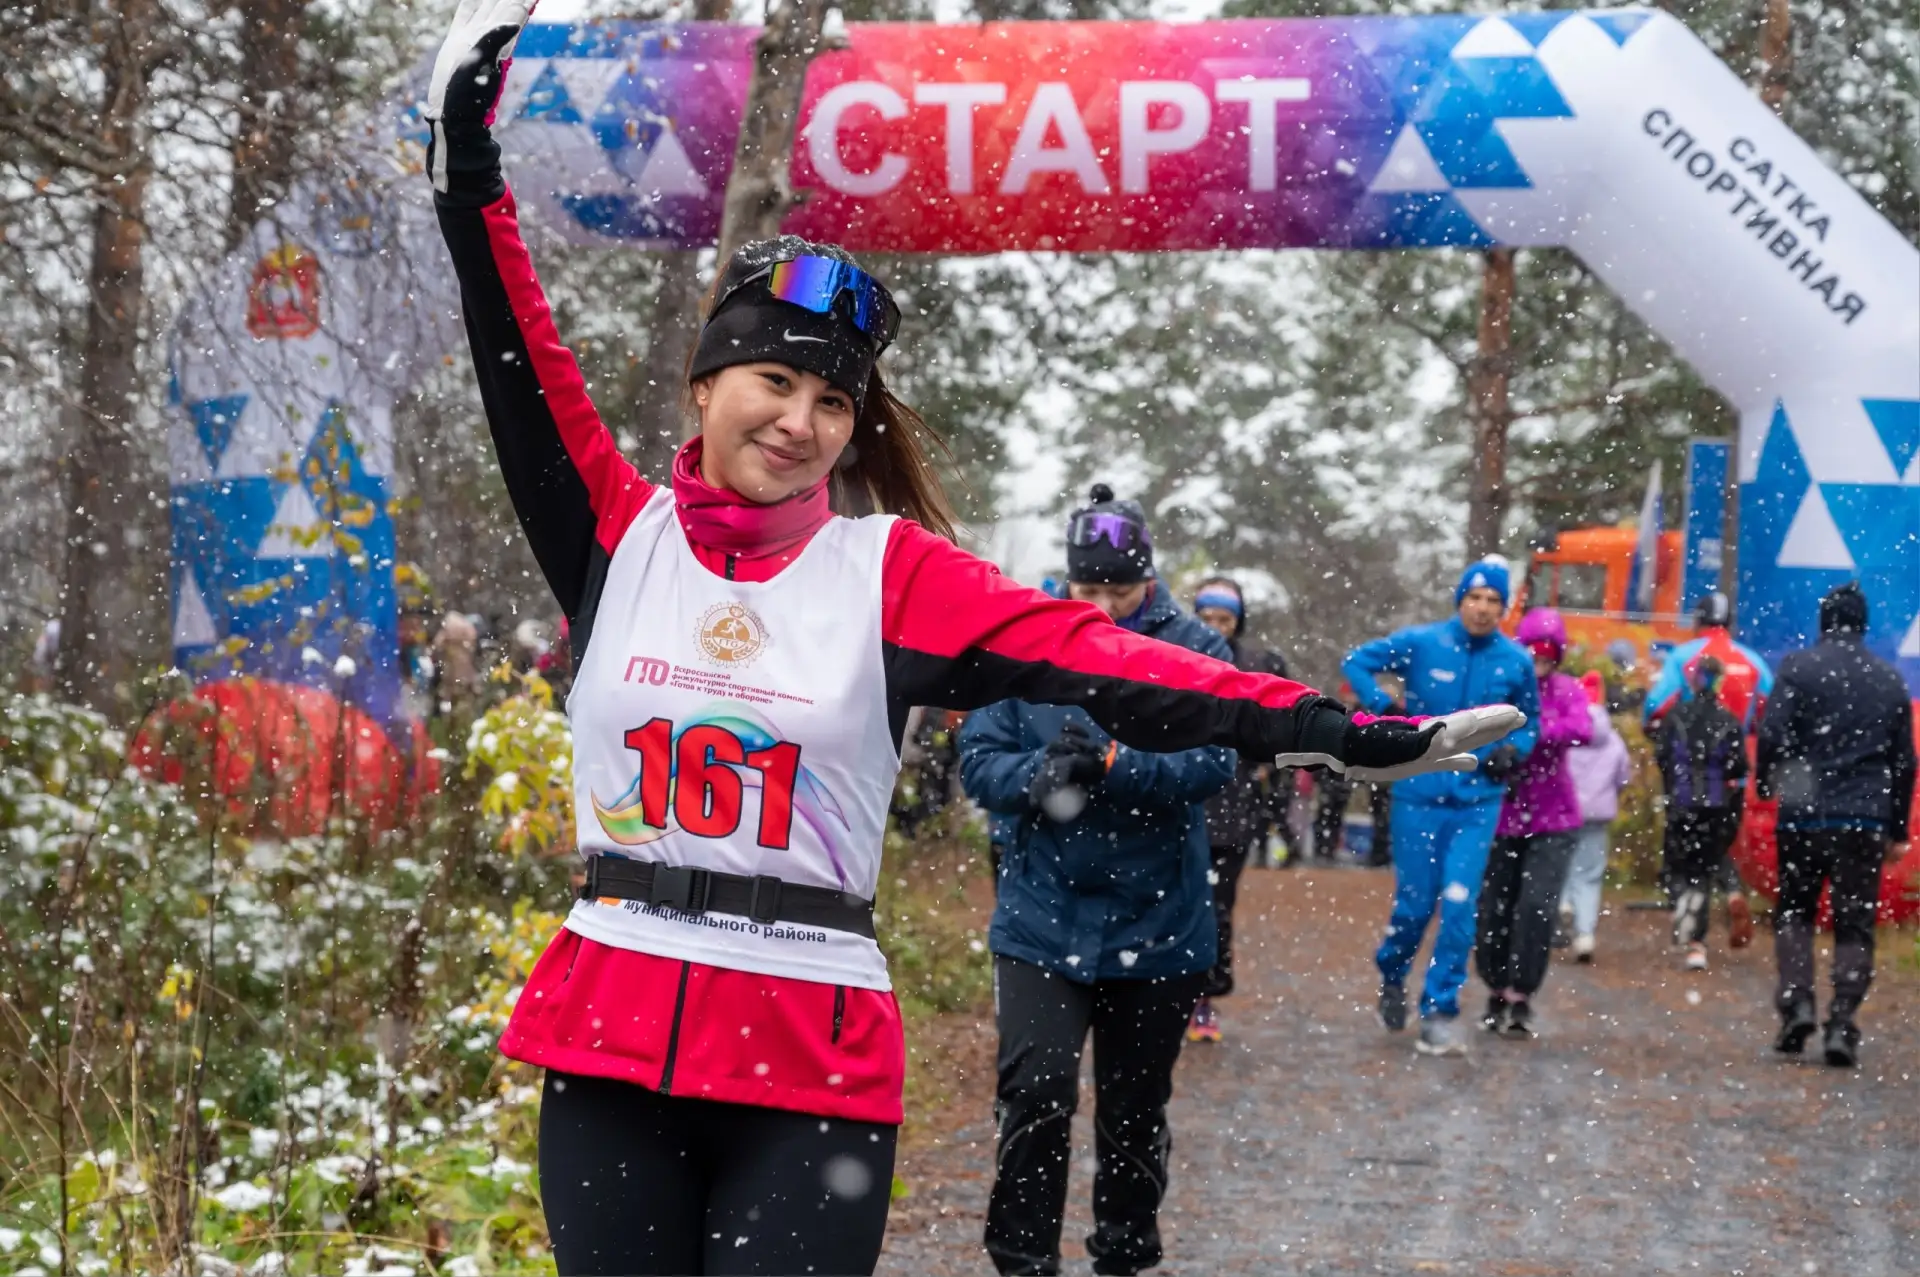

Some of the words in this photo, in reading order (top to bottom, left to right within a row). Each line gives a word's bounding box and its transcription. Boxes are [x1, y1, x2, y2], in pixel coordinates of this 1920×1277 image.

[808, 78, 1311, 195] СТАРТ
[1643, 108, 1867, 325] СПОРТИВНАЯ
[1729, 136, 1831, 243] САТКА
[671, 673, 776, 697] физкультурно-спортивный
[777, 692, 815, 705] комплекс
[673, 665, 731, 680] Всероссийский
[704, 686, 726, 697] труду
[624, 717, 802, 851] 161
[624, 900, 759, 934] муниципального
[764, 924, 827, 943] района
